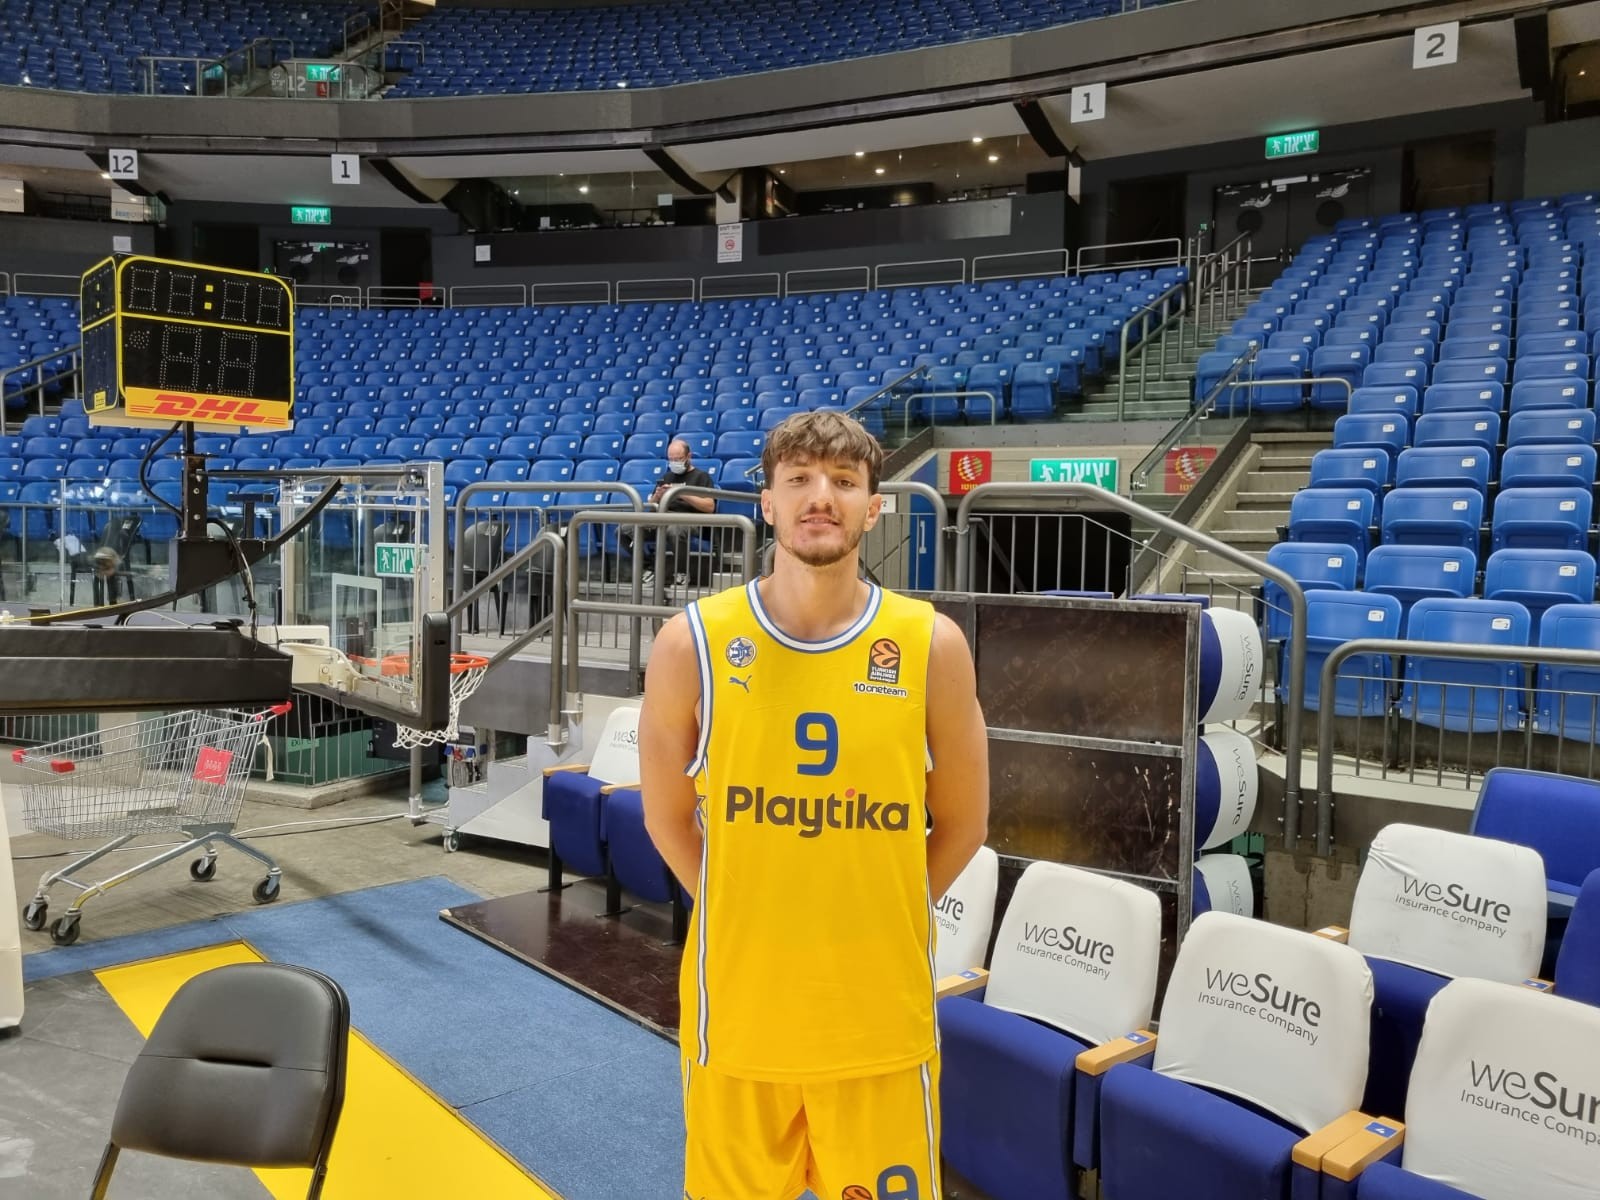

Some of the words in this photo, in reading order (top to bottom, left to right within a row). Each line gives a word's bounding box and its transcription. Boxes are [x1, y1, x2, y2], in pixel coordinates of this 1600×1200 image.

[1426, 33, 1446, 59] 2
[288, 75, 306, 92] 12
[1082, 92, 1093, 114] 1
[1283, 133, 1315, 154] יציאה
[112, 155, 134, 173] 12
[340, 160, 351, 178] 1
[305, 208, 328, 223] יציאה
[152, 394, 266, 423] DHL
[795, 712, 839, 776] 9
[726, 785, 910, 838] Playtika
[935, 895, 964, 921] ure
[1395, 893, 1449, 917] Insurance
[1451, 910, 1507, 938] Company
[1404, 875, 1511, 923] weSure
[1025, 921, 1114, 965] weSure
[1016, 942, 1063, 962] Insurance
[1064, 954, 1110, 981] Company
[1206, 967, 1321, 1027] weSure
[1198, 991, 1257, 1016] Insurance
[1258, 1007, 1318, 1046] Company
[1460, 1089, 1540, 1125] Insurance
[1471, 1060, 1600, 1125] weSur
